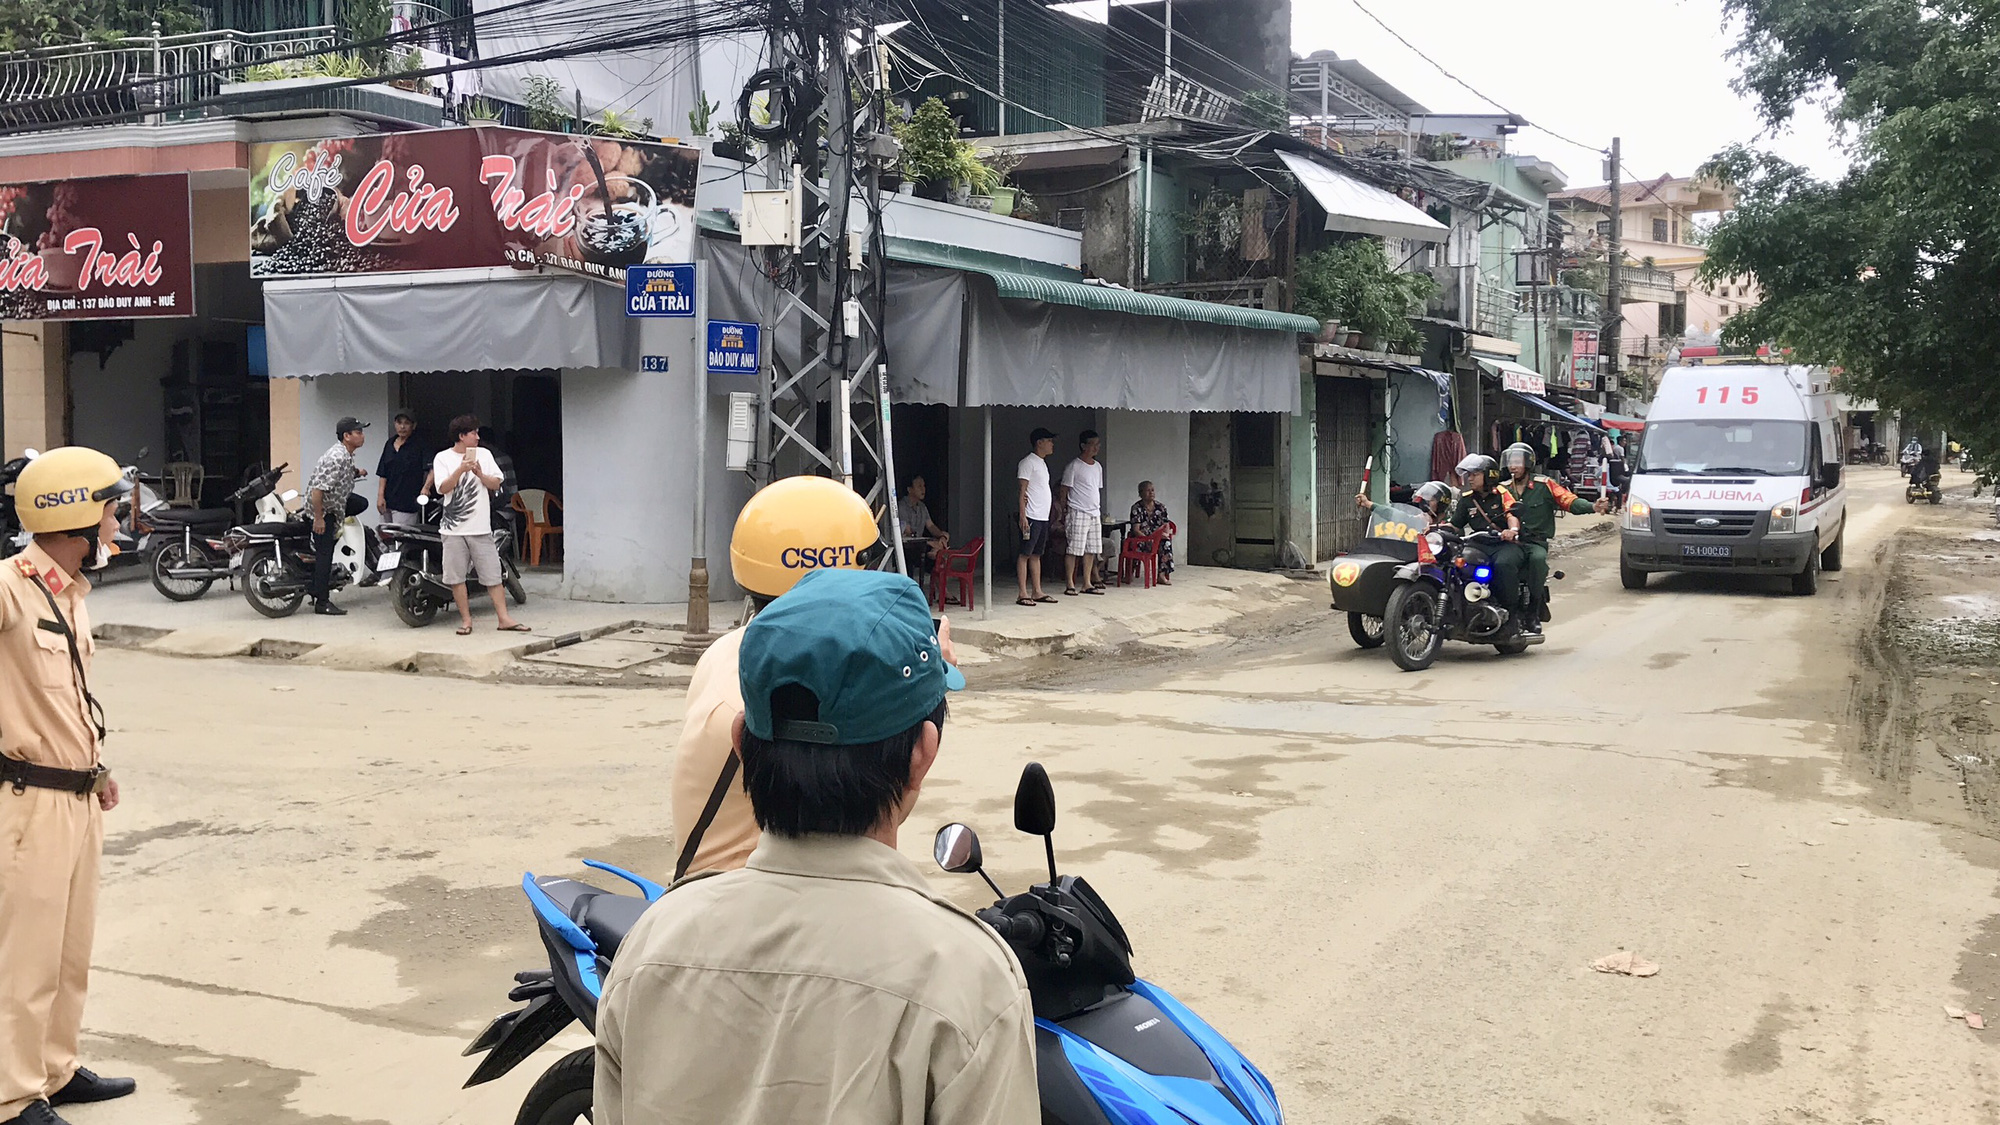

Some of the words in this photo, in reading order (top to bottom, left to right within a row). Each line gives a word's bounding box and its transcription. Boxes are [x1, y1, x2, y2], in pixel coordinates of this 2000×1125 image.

[268, 149, 343, 204] Café
[345, 159, 460, 247] Cửa
[480, 154, 585, 238] Trài
[0, 236, 49, 292] ửa
[64, 227, 163, 291] Trài
[584, 261, 605, 275] DUY
[646, 269, 674, 278] ĐƯỜNG
[47, 299, 61, 312] ĐỊA
[82, 298, 97, 310] 137
[98, 295, 115, 309] ĐÀO
[116, 297, 132, 308] DUY
[134, 296, 151, 307] ANH
[158, 291, 176, 307] HUẾ
[631, 291, 657, 311] CỬA
[659, 291, 690, 311] TRÀI
[722, 325, 743, 335] ĐƯỜNG
[643, 357, 667, 370] 137
[709, 348, 724, 366] ĐÀO
[725, 352, 740, 367] DUY
[740, 353, 755, 368] ANH
[1697, 386, 1759, 405] 115
[34, 487, 89, 509] CSGT
[781, 545, 854, 568] CSGT
